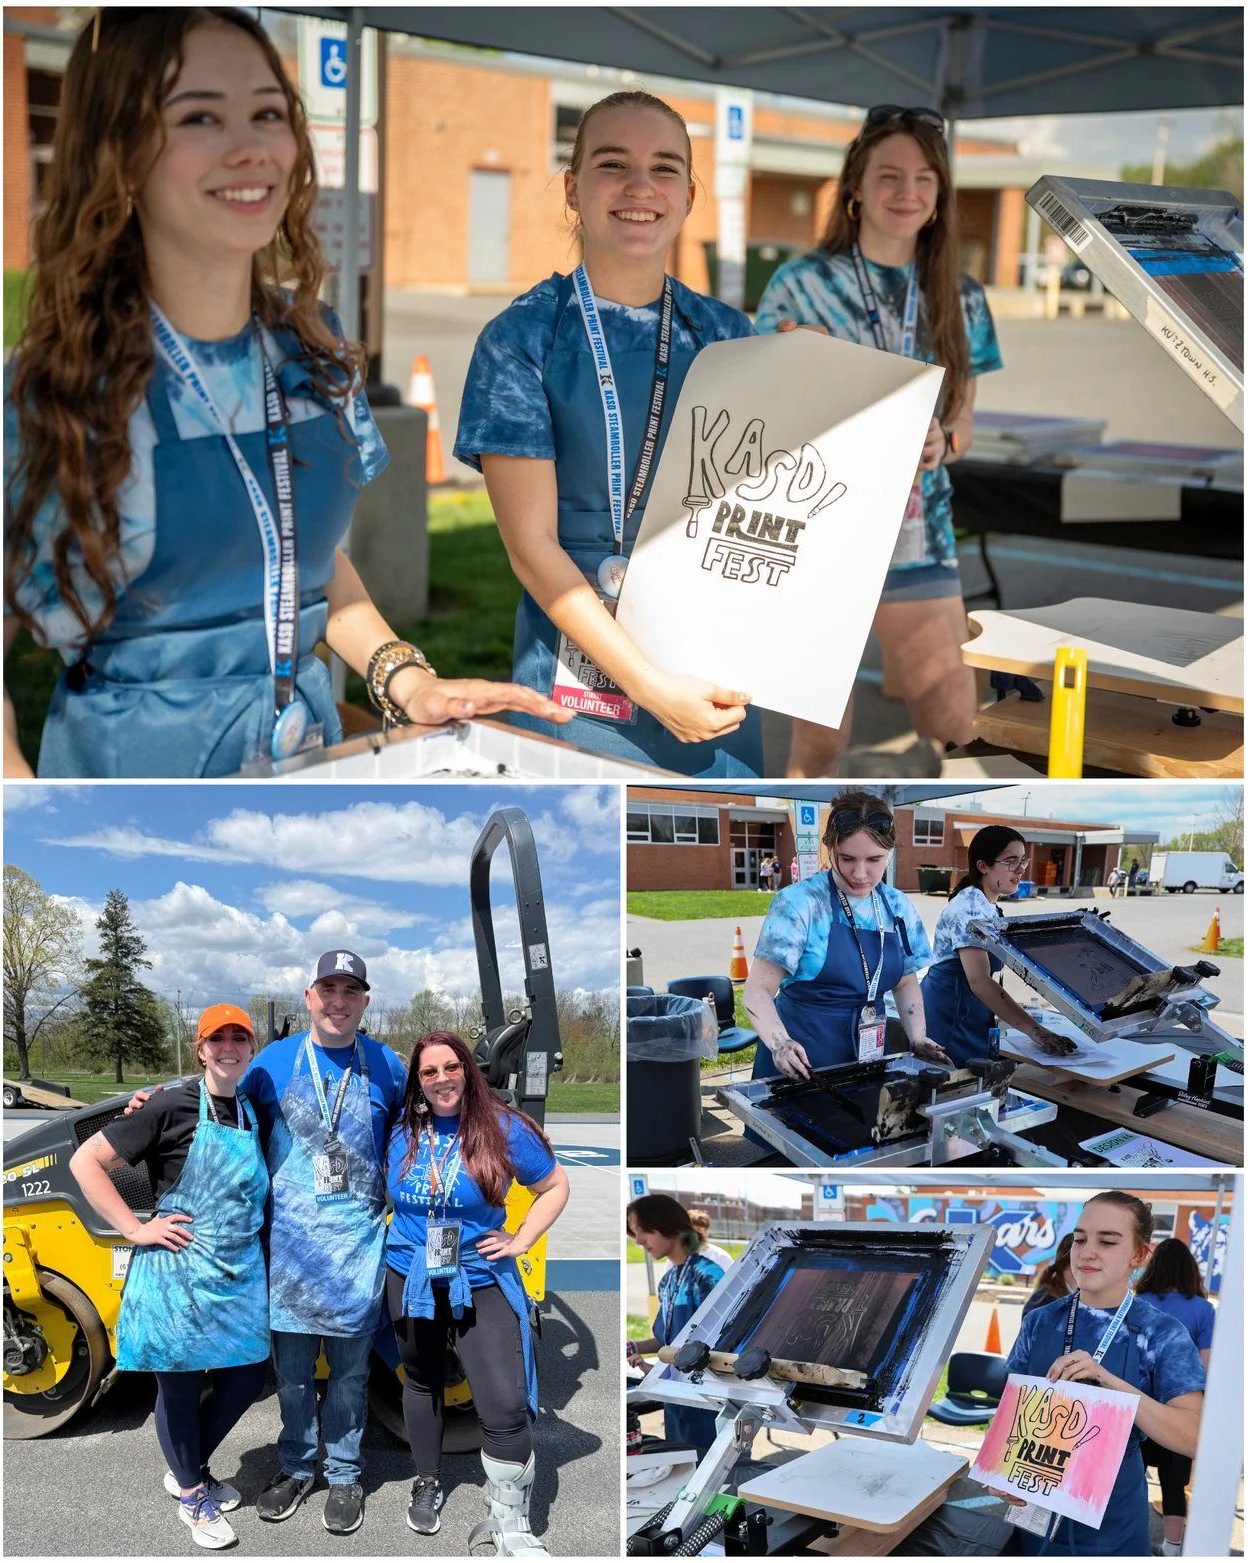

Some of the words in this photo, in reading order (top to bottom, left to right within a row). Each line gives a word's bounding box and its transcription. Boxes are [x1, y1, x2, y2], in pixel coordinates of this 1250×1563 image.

[587, 313, 601, 336] PRINT
[660, 292, 673, 344] STEAMROLLER
[592, 336, 609, 370] FESTIVAL
[659, 343, 669, 363] KASD
[1160, 325, 1203, 370] KUTZTOWN
[1202, 369, 1217, 387] H.S.
[604, 390, 617, 411] KASD
[651, 381, 665, 415] FESTIVAL
[608, 412, 621, 470] STEAMROLLER
[647, 416, 660, 440] PRINT
[272, 448, 291, 500] FESTIVAL
[611, 472, 621, 498] PRINT
[632, 440, 655, 497] STEAMROLLER
[279, 502, 294, 537] PRINT
[612, 499, 622, 536] FESTIVAL
[711, 500, 806, 553] PRINT
[701, 537, 797, 587] FEST
[278, 538, 296, 621] STEAMROLLER
[277, 622, 294, 654] KASD
[560, 694, 621, 716] VOLUNTEER
[335, 952, 354, 972] K
[1093, 1137, 1123, 1153] DESIGN
[22, 1163, 40, 1178] SL
[22, 1180, 51, 1197] 1222
[316, 1193, 348, 1202] VOLUNTEER
[857, 1413, 866, 1424] 2
[1017, 1438, 1072, 1474] PRINT
[1007, 1461, 1063, 1497] FEST
